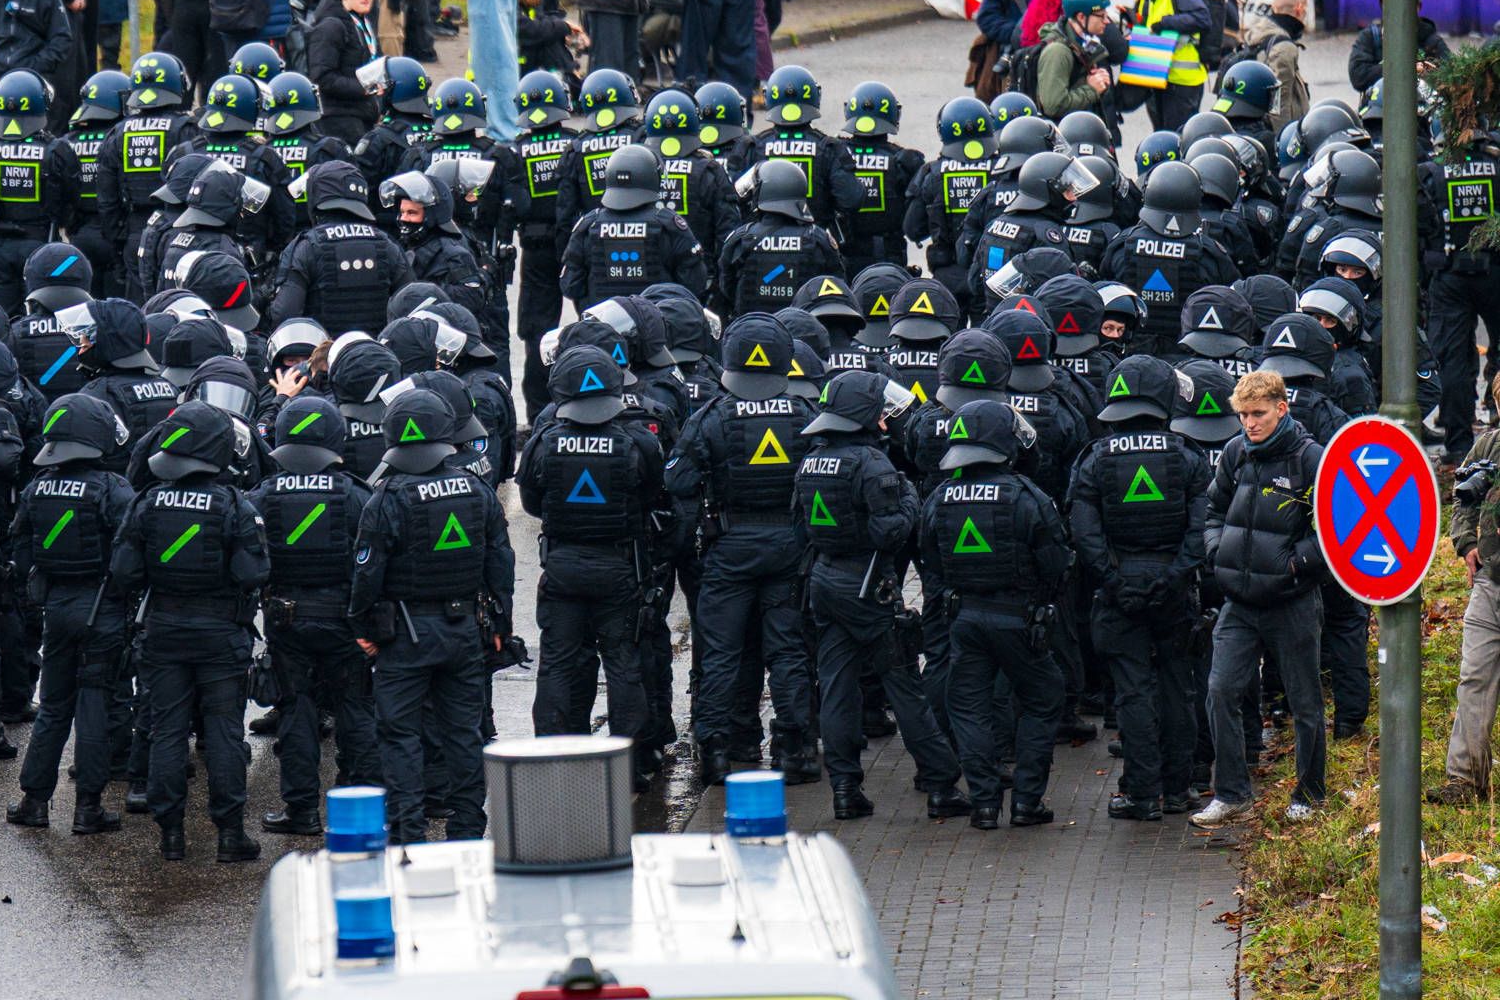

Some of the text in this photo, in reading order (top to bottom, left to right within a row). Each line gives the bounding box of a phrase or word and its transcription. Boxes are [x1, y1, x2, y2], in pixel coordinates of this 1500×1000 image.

[134, 68, 166, 84] 3 2
[235, 61, 268, 78] 3 2
[418, 76, 426, 90] 3
[1236, 80, 1246, 96] 2
[88, 85, 97, 99] 2
[288, 90, 299, 104] 2
[520, 89, 554, 106] 3 2
[585, 88, 618, 107] 3 2
[772, 85, 811, 100] 3 2
[20, 98, 29, 111] 2
[208, 92, 238, 108] 3 2
[436, 92, 474, 110] 3 2
[850, 96, 890, 113] 3 2
[716, 104, 725, 119] 2
[999, 107, 1032, 121] 3 2
[124, 118, 172, 132] POLIZEI
[653, 113, 687, 129] 3 2
[952, 118, 986, 136] 3 2
[131, 136, 155, 147] NRW
[582, 134, 632, 152] POLIZEI
[765, 141, 816, 156] POLIZEI
[128, 148, 158, 157] 3 BF 24
[1142, 152, 1150, 166] 3
[5, 166, 29, 178] NRW
[535, 160, 559, 172] NRW
[1444, 162, 1496, 178] POLIZEI
[2, 179, 33, 188] 3 BF 23
[534, 172, 553, 182] 3 BF
[592, 172, 597, 180] 3
[952, 176, 977, 188] NRW
[670, 192, 682, 200] 22
[868, 188, 878, 198] 22
[949, 189, 968, 198] 3 BF
[1458, 184, 1483, 196] NRW
[1454, 196, 1488, 206] 3 BF 21
[326, 224, 376, 240] POLIZEI
[600, 223, 646, 238] POLIZEI
[988, 220, 1020, 239] POLIZEI
[1136, 239, 1186, 258] POLIZEI
[610, 266, 642, 277] SH 215
[788, 269, 794, 278] 1
[760, 286, 794, 297] SH 215 B
[1141, 291, 1154, 301] SH
[890, 352, 938, 367] POLIZE
[132, 384, 174, 400] POLIZEI
[736, 400, 792, 416] POLIZEI
[558, 437, 612, 454] POLIZEI
[1110, 434, 1167, 452] POLIZEI
[801, 457, 841, 475] POLIZEI
[35, 480, 86, 498] POLIZEI
[276, 474, 332, 492] POLIZEI
[418, 477, 472, 500] POLIZEI
[944, 484, 1000, 502] POLIZEI
[156, 492, 212, 511] POLIZEI
